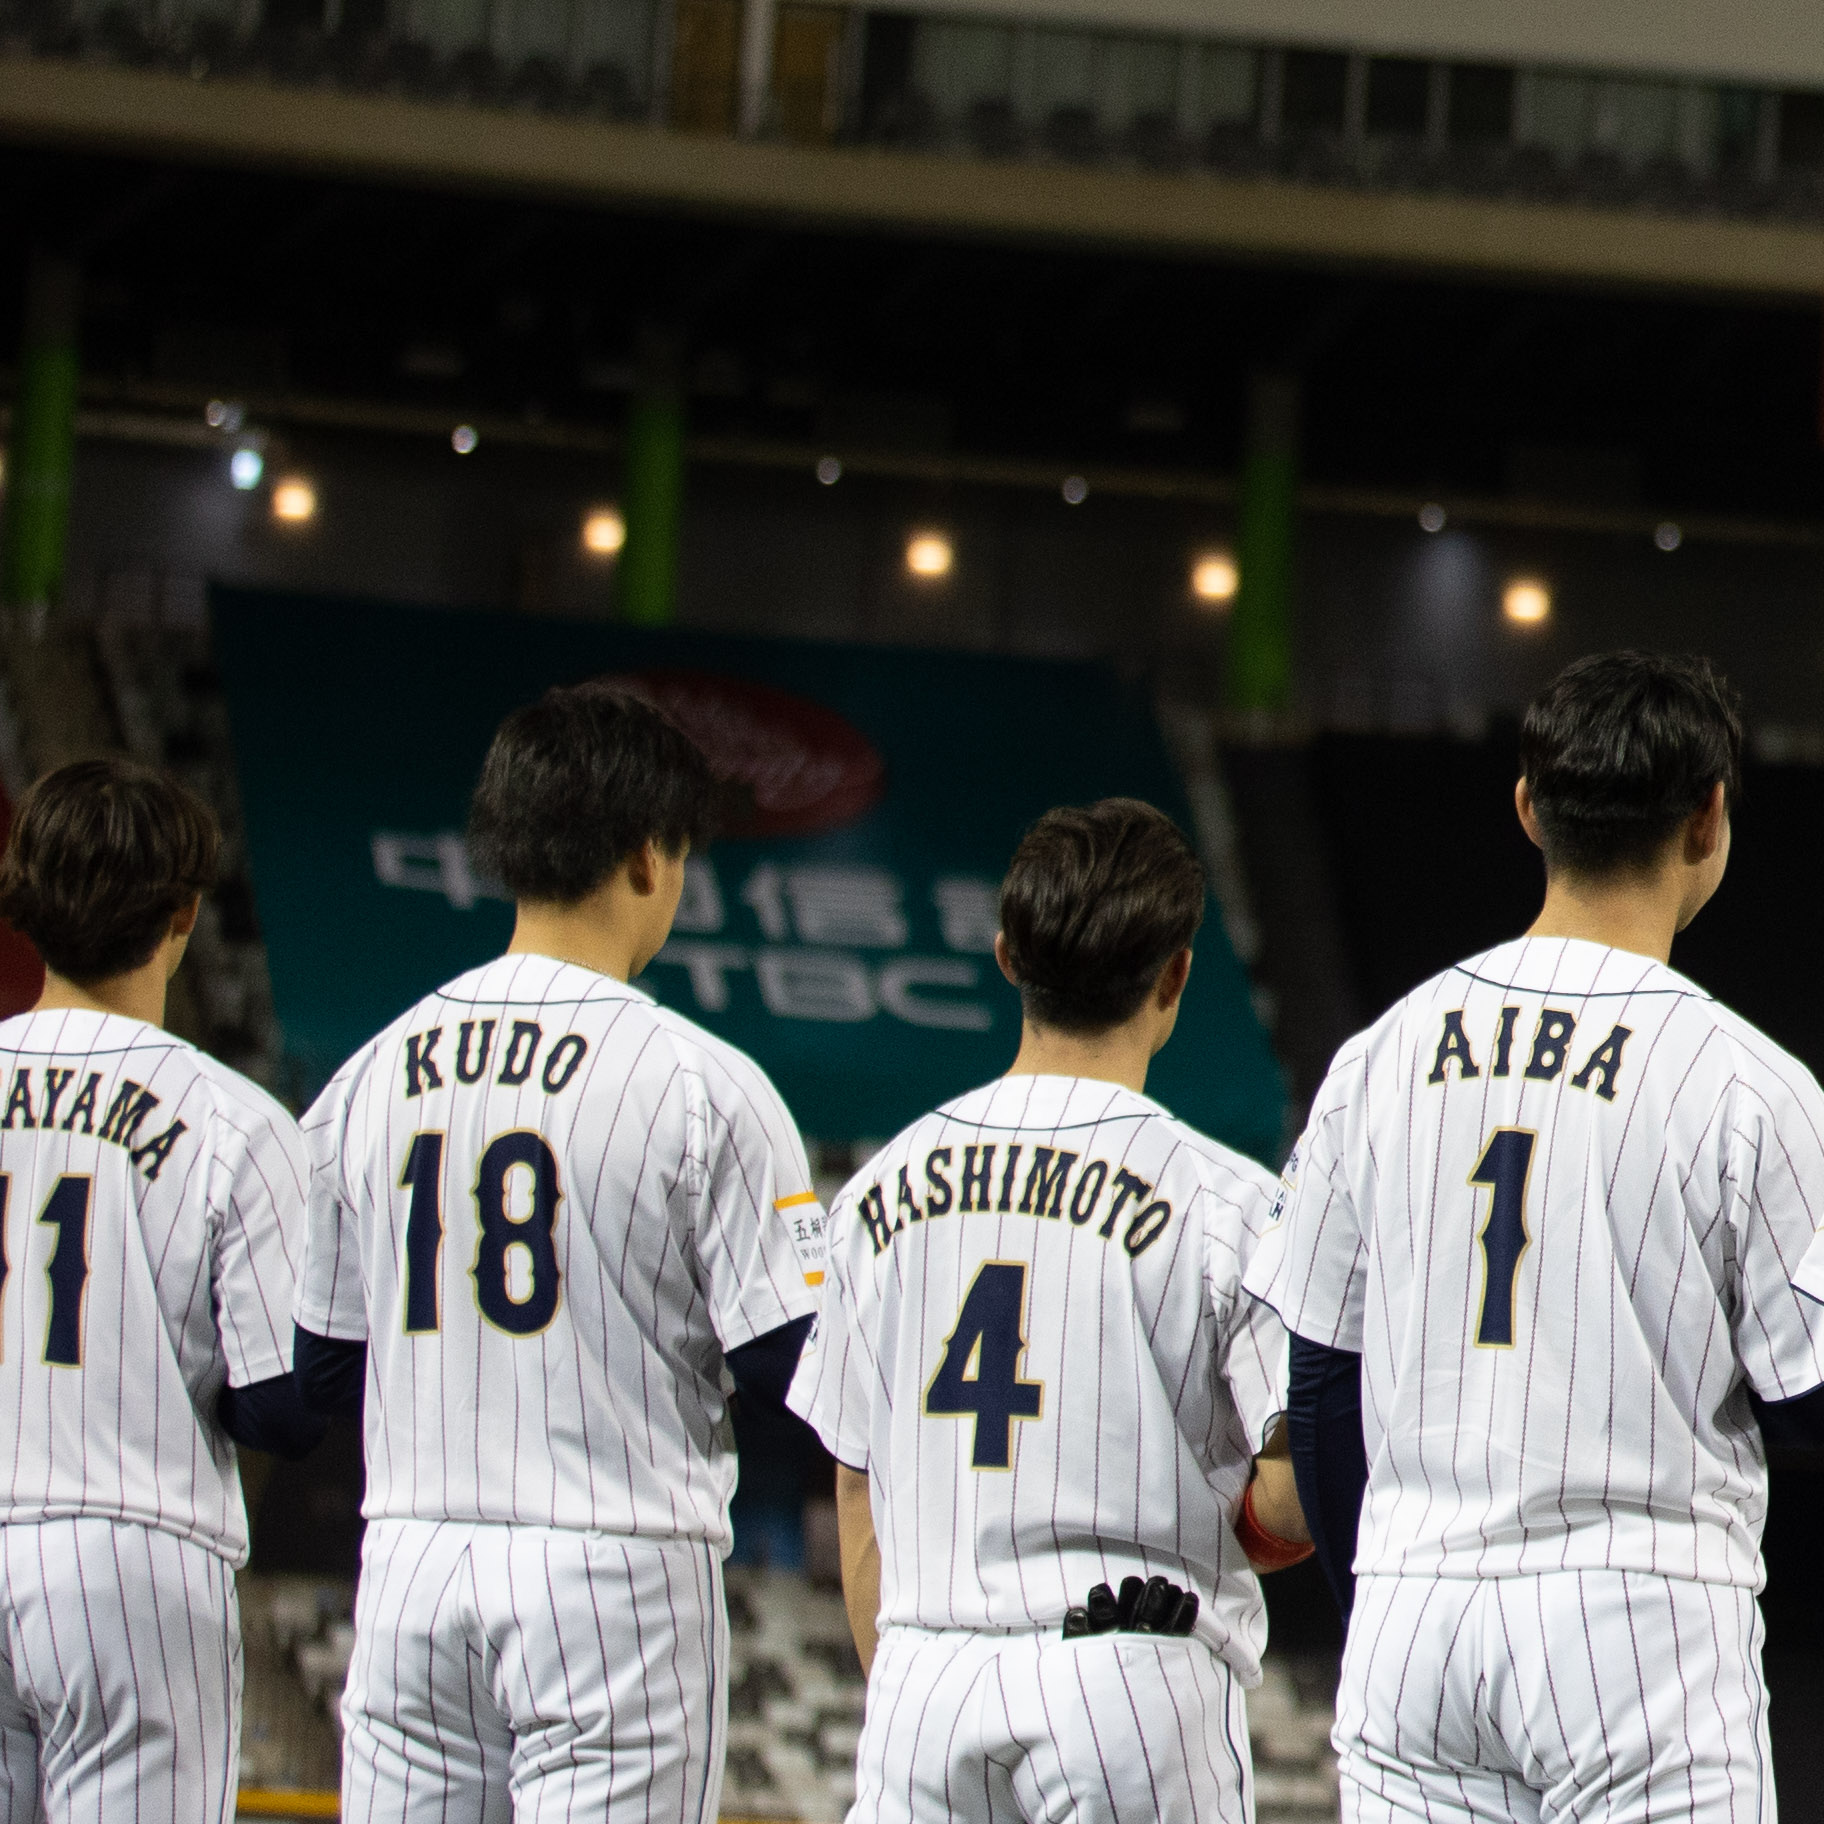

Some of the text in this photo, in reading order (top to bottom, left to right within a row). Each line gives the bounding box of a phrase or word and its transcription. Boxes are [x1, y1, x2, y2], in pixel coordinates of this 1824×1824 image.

[632, 939, 993, 1032] TBC
[405, 1018, 589, 1099] KUDO
[1427, 1005, 1634, 1104] AIBA
[0, 1067, 189, 1182] AYAMA
[397, 1127, 566, 1339] 18
[857, 1143, 1172, 1259] HASHIMOTO
[1465, 1125, 1538, 1350] 1
[0, 1171, 94, 1369] 1
[922, 1259, 1045, 1472] 4
